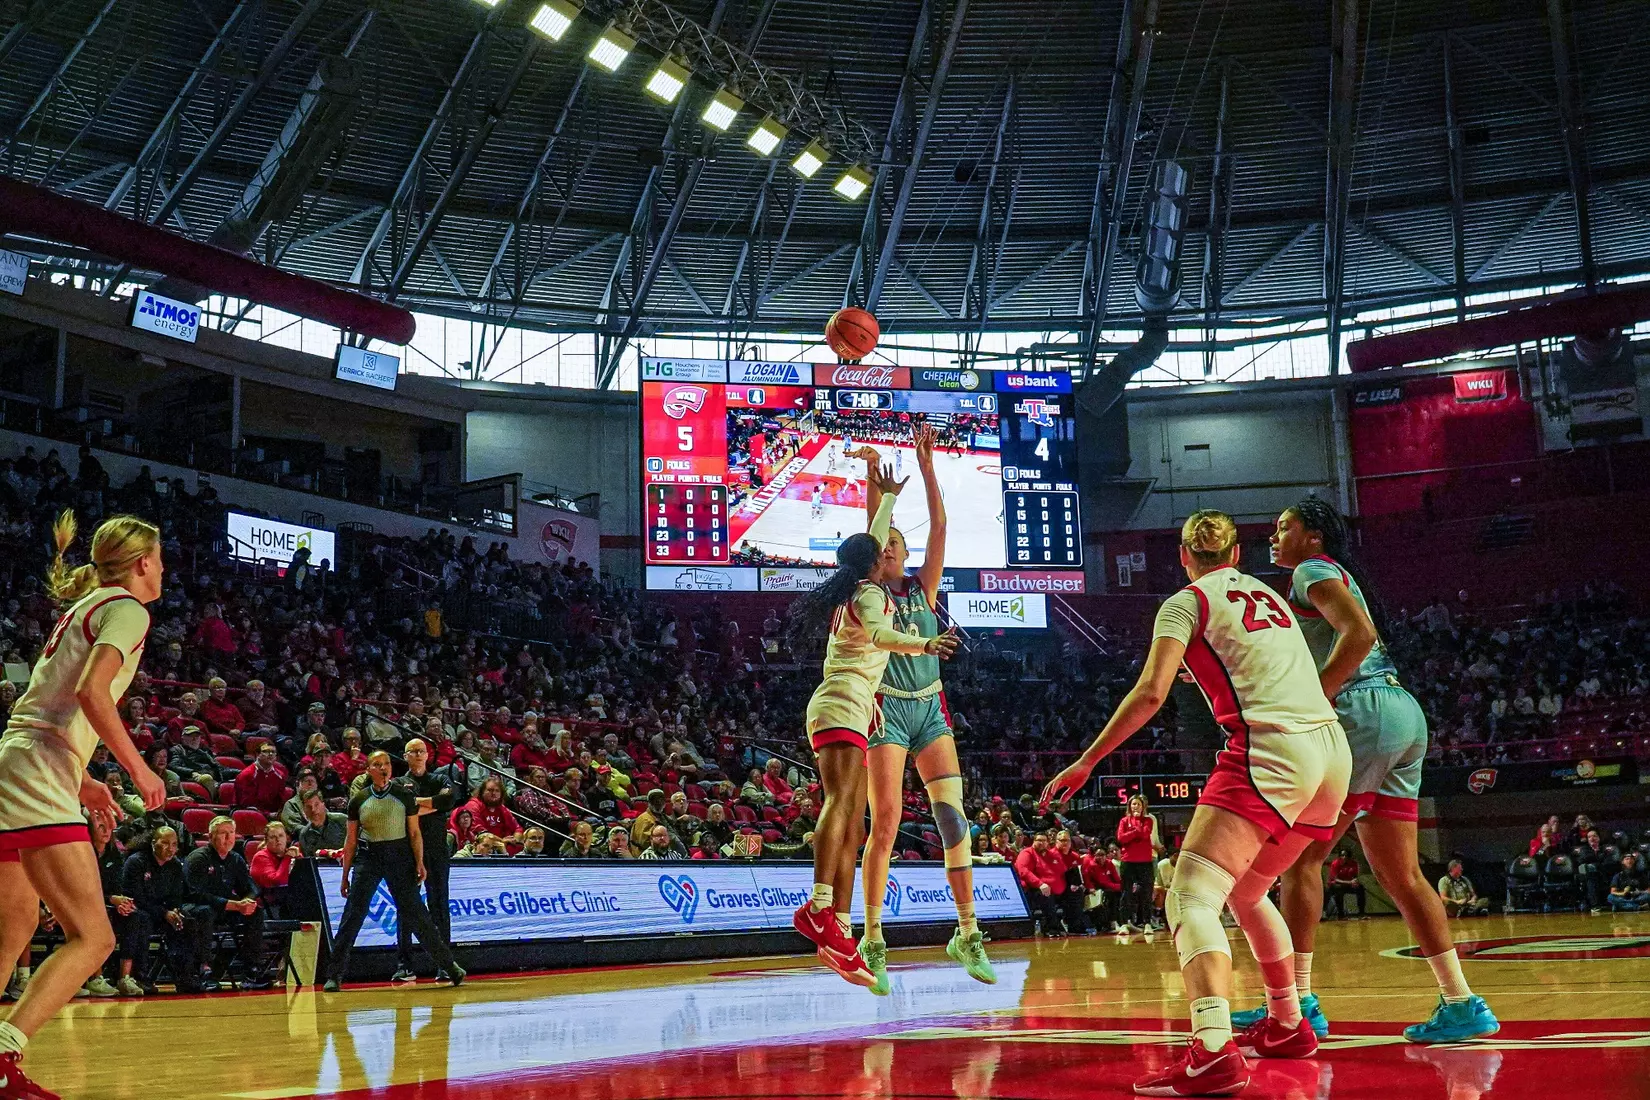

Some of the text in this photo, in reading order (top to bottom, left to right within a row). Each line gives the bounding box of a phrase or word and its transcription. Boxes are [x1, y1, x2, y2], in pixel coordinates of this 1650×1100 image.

[139, 296, 197, 327] ATMOS
[154, 318, 195, 337] energy
[339, 366, 365, 377] KERRICK
[366, 371, 394, 383] BACHERT
[645, 362, 673, 376] HIG
[745, 364, 784, 376] LOGAN
[832, 365, 893, 388] Coca-Cola
[922, 370, 960, 382] CHEETAH
[752, 390, 761, 403] 4
[815, 389, 829, 400] 1ST
[851, 393, 879, 407] 7:08
[982, 398, 991, 410] 4
[678, 427, 693, 451] 5
[1035, 437, 1049, 461] 4
[652, 461, 690, 470] 0 FOULS
[1008, 469, 1041, 479] 0 FOULS
[659, 489, 718, 500] 1 0 0
[658, 504, 719, 514] 3 0 0
[1018, 498, 1070, 508] 3 0 0
[657, 517, 719, 528] 10 0 0
[1017, 511, 1071, 521] 15 0 0
[1043, 524, 1049, 534] 0
[1066, 525, 1072, 534] 0
[251, 527, 296, 551] HOME
[656, 531, 719, 542] 23 0 0
[1017, 537, 1073, 548] 22 0 0
[656, 546, 720, 557] 33 0 0
[1018, 550, 1074, 561] 23 0 0
[763, 573, 795, 586] Prairie
[815, 569, 828, 578] We
[796, 579, 821, 590] Kentu
[982, 573, 1082, 592] Budweiser
[968, 600, 1009, 613] HOME
[1226, 590, 1292, 633] 23
[1117, 789, 1128, 804] 5
[1156, 783, 1189, 798] 7:08
[706, 887, 809, 908] Graves Gilbert
[906, 886, 947, 903] Graves
[983, 885, 1011, 901] Clinic
[451, 891, 620, 917] aves Gilbert Clinic
